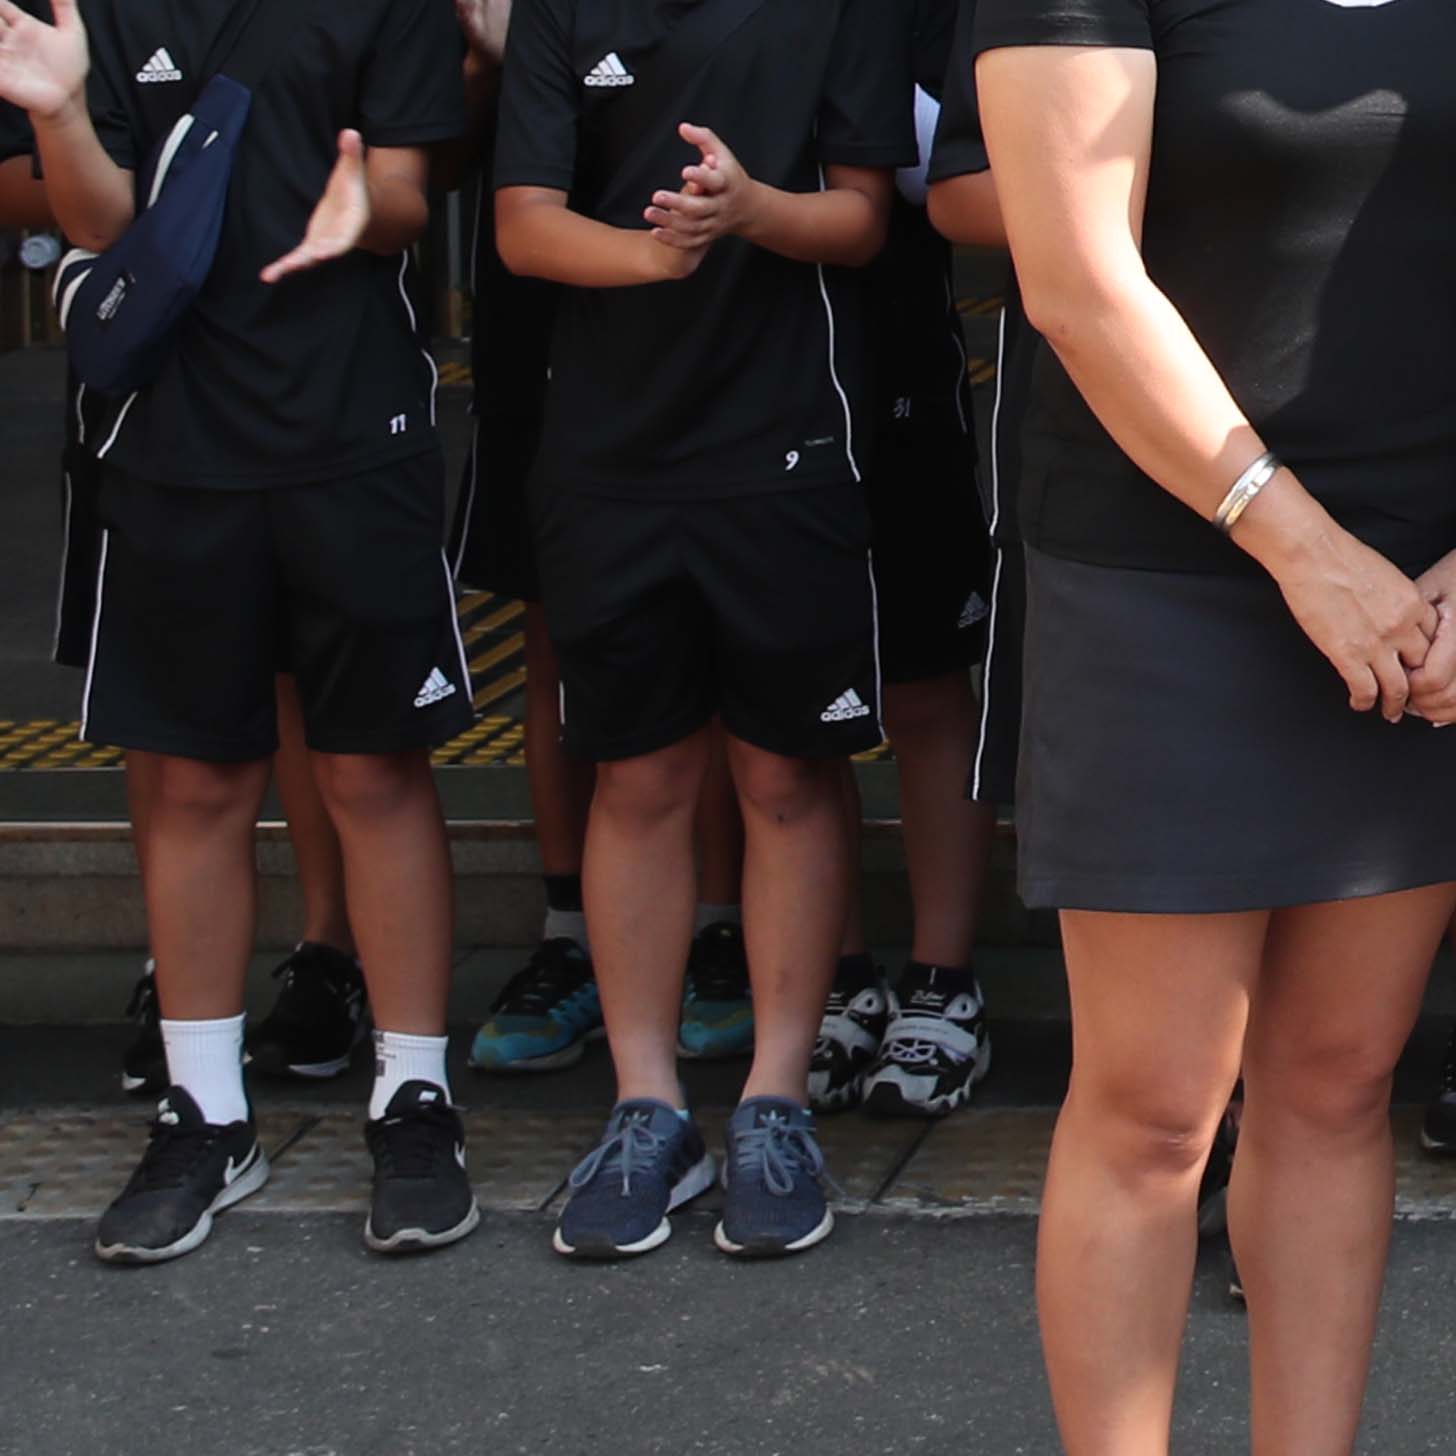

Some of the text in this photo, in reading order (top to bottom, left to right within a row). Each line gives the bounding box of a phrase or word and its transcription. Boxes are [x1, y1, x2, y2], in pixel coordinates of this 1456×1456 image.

[136, 69, 182, 83] adidas
[584, 74, 635, 87] adidas
[389, 413, 407, 434] 11
[784, 449, 800, 472] 9
[820, 704, 871, 723] adidas
